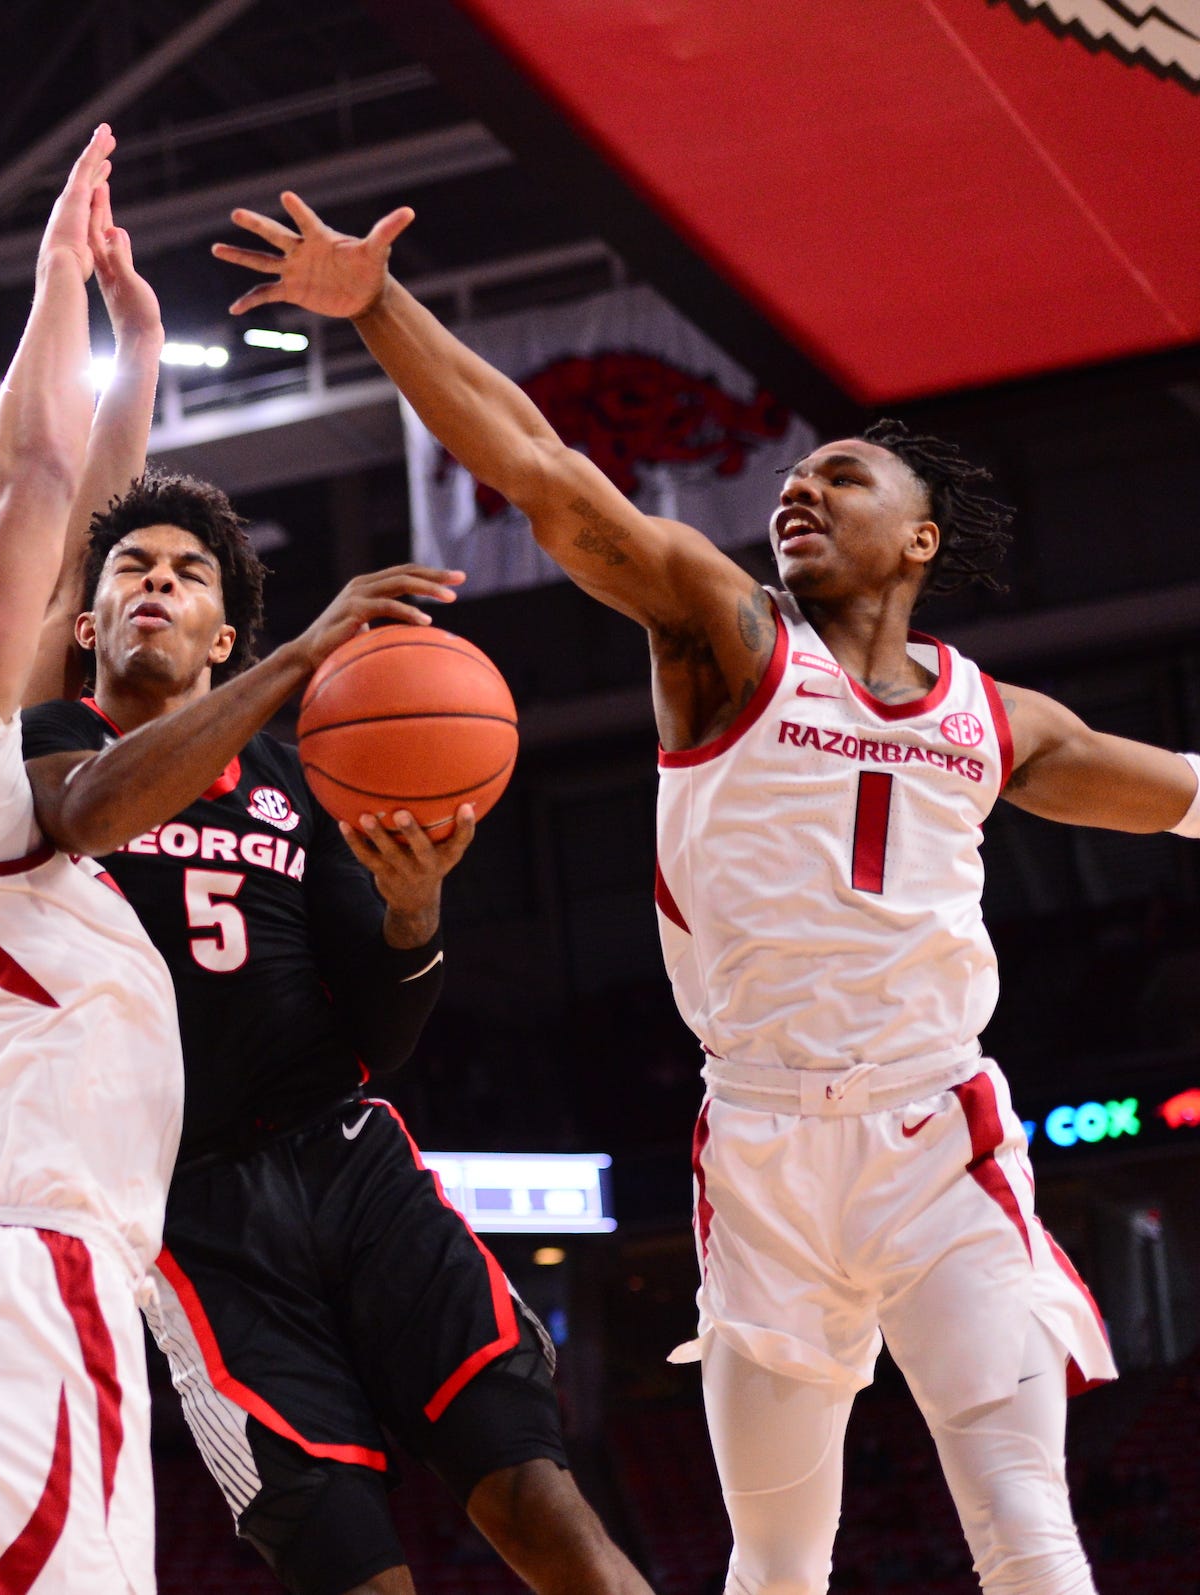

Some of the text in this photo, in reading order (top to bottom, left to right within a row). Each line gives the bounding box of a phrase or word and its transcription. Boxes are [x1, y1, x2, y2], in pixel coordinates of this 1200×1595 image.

[778, 720, 984, 783] RAZORBACKS
[943, 713, 982, 745] SEC
[253, 788, 288, 819] SEC
[851, 770, 893, 895] 1
[116, 822, 306, 883] EORGIA
[184, 867, 249, 974] 5
[1046, 1097, 1141, 1147] COX
